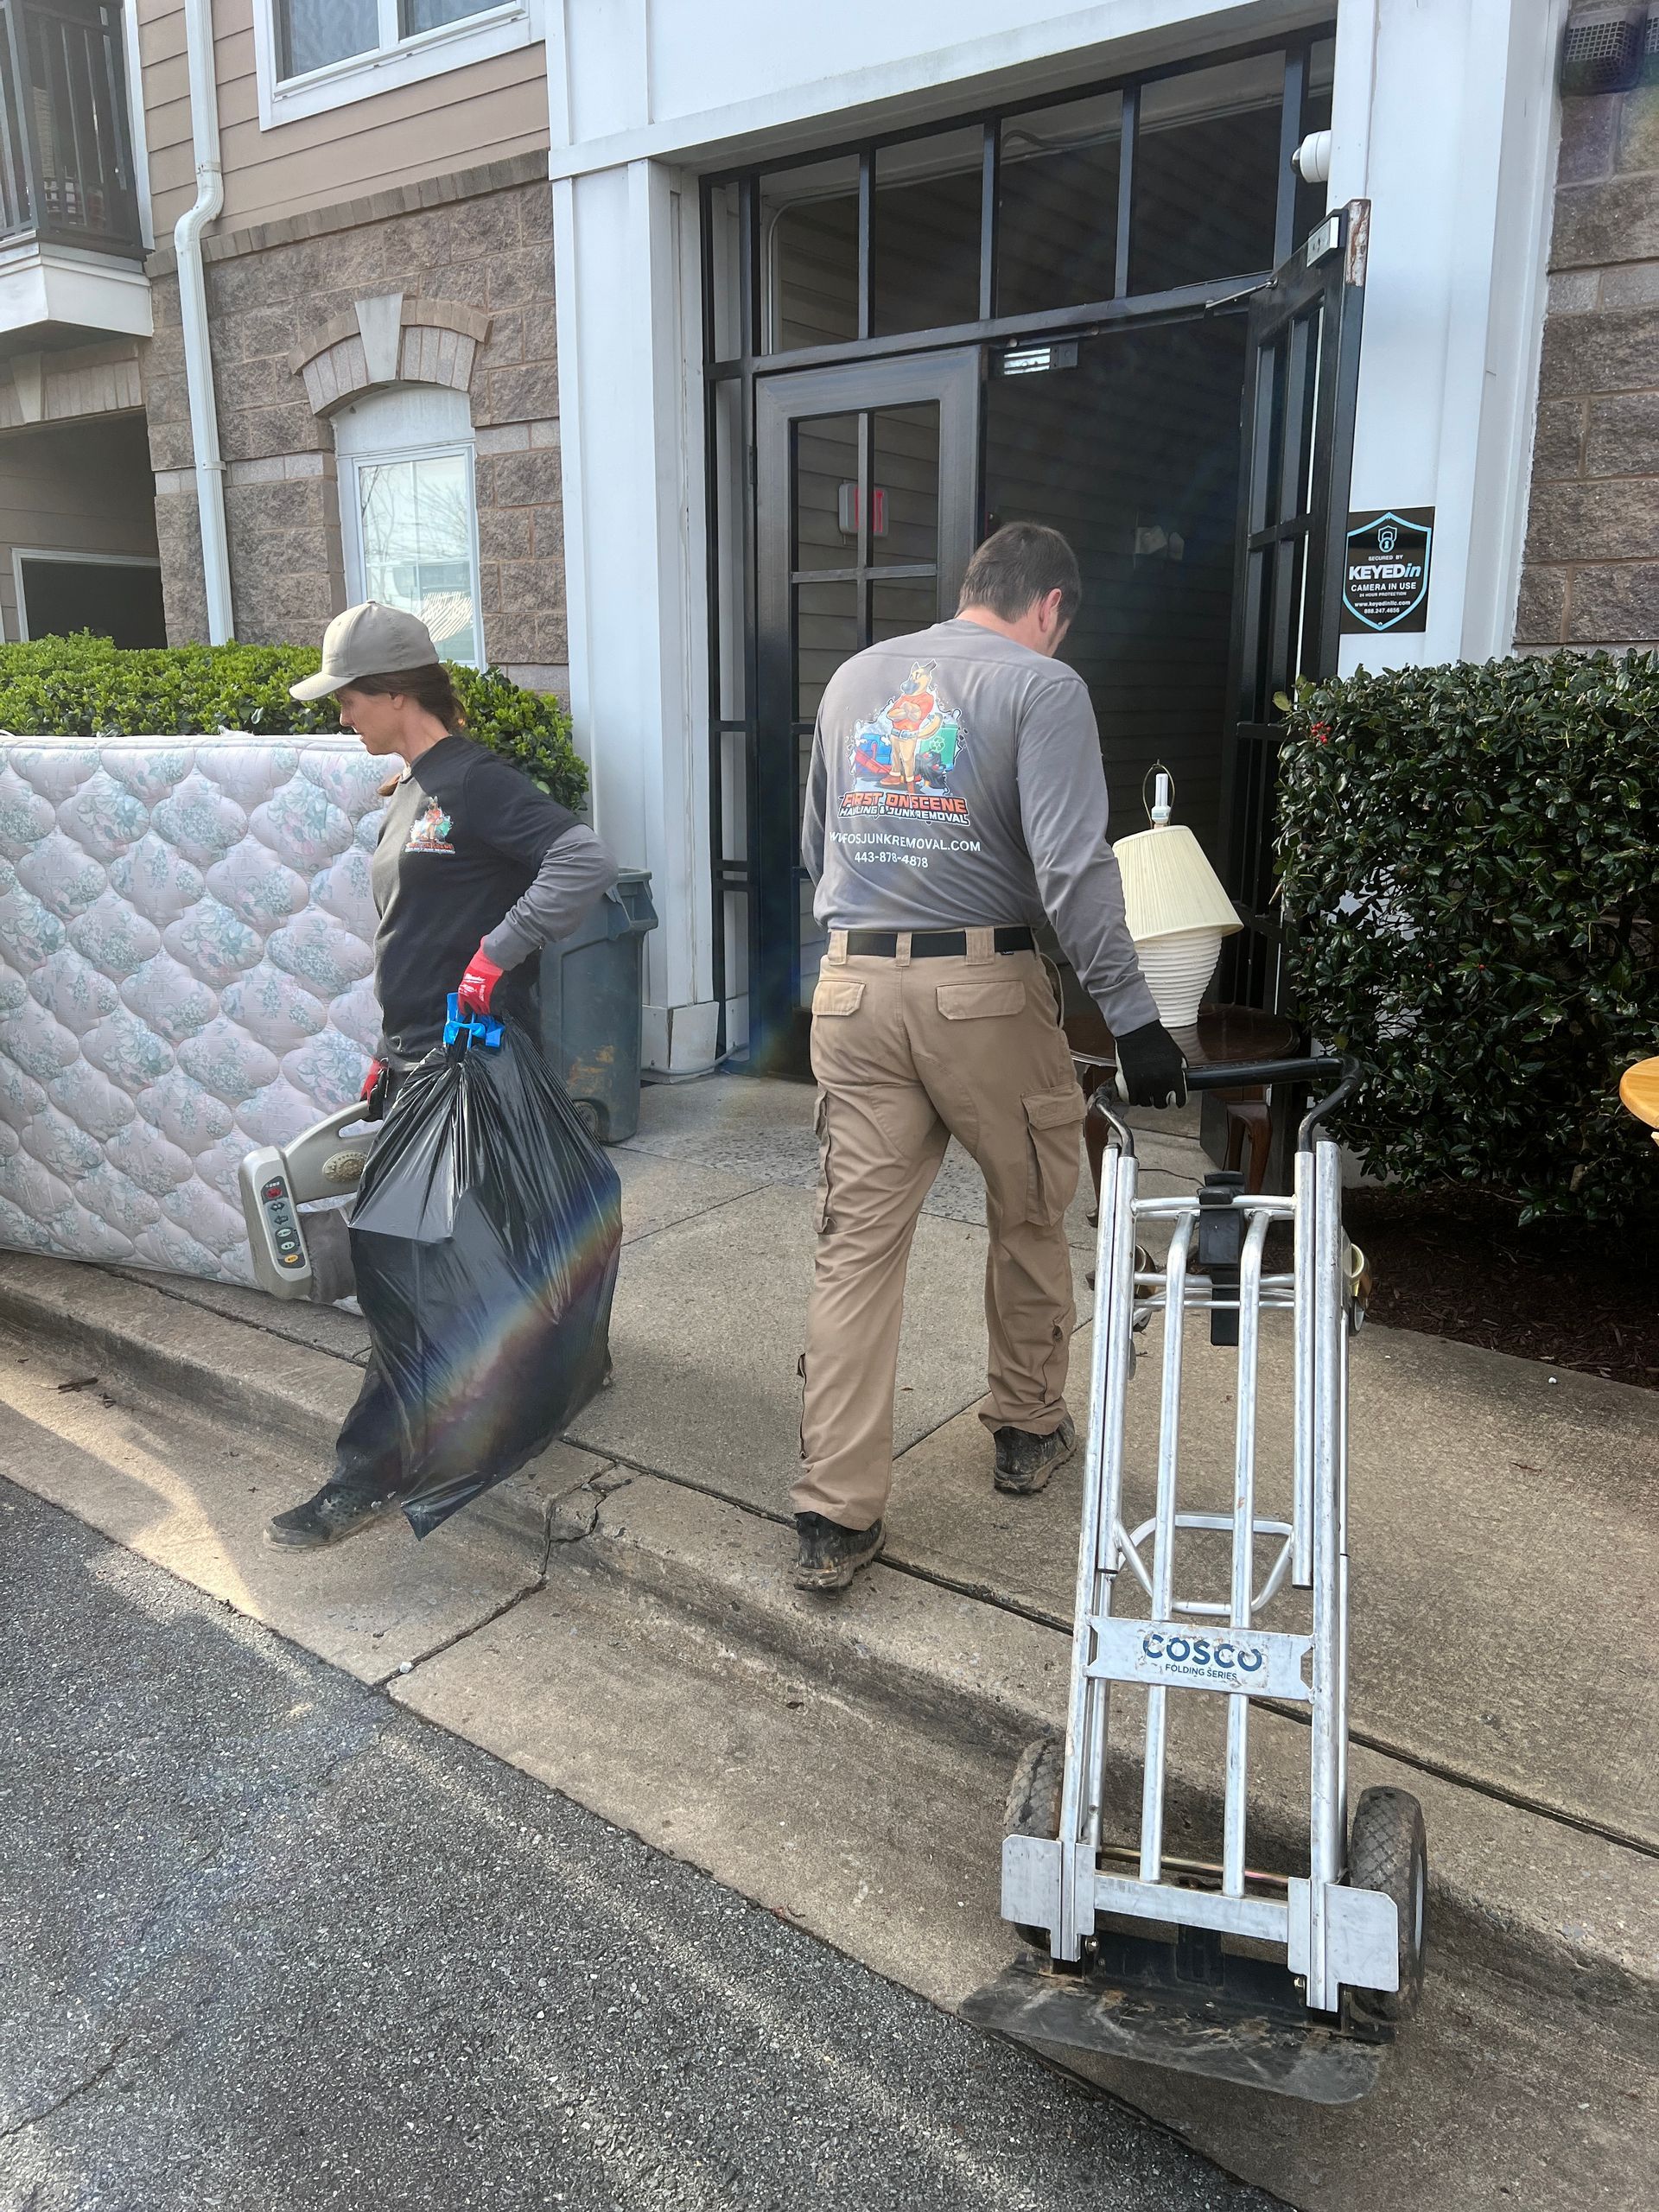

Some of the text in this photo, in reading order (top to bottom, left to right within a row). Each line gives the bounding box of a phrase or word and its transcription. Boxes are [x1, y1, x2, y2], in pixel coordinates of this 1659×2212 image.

[1349, 563, 1421, 581] KEYEDin
[1351, 583, 1386, 592] CAMERA
[1399, 582, 1417, 590] USE
[855, 851, 929, 868] 443-878-4878
[1143, 1633, 1262, 1672] COSCO
[1165, 1664, 1237, 1681] FOLDING SERIES
